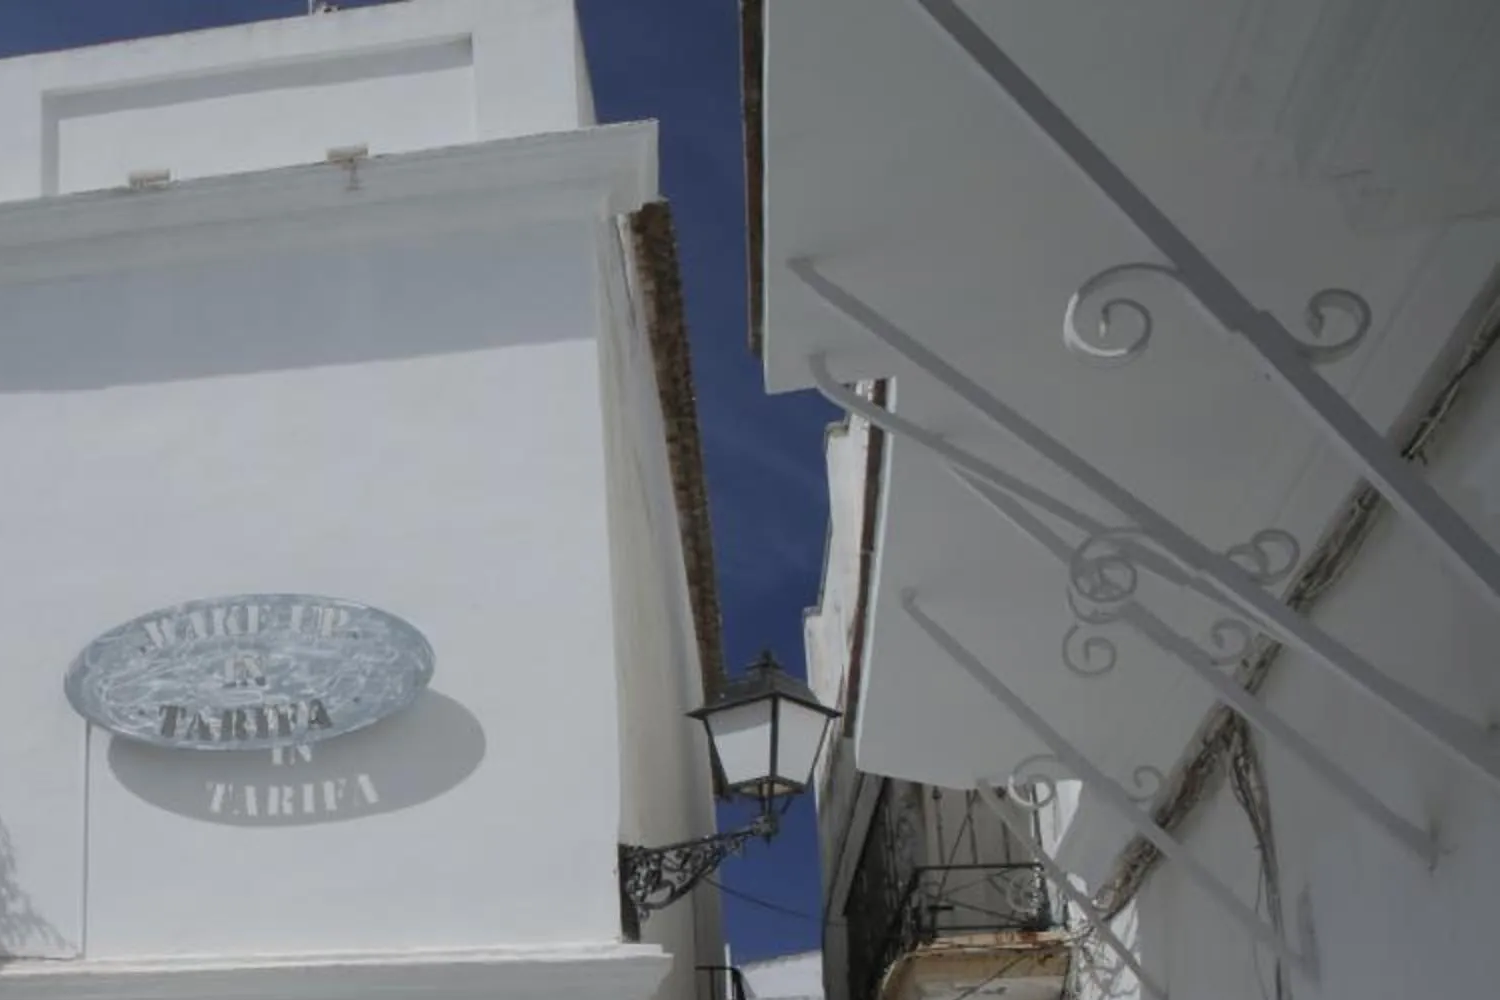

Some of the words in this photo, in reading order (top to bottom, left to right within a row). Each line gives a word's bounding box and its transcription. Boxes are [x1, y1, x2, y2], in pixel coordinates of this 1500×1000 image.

[142, 604, 271, 649] WAKE
[290, 604, 356, 638] UP
[158, 698, 333, 740] TARIFA
[205, 772, 381, 817] TARIFA
